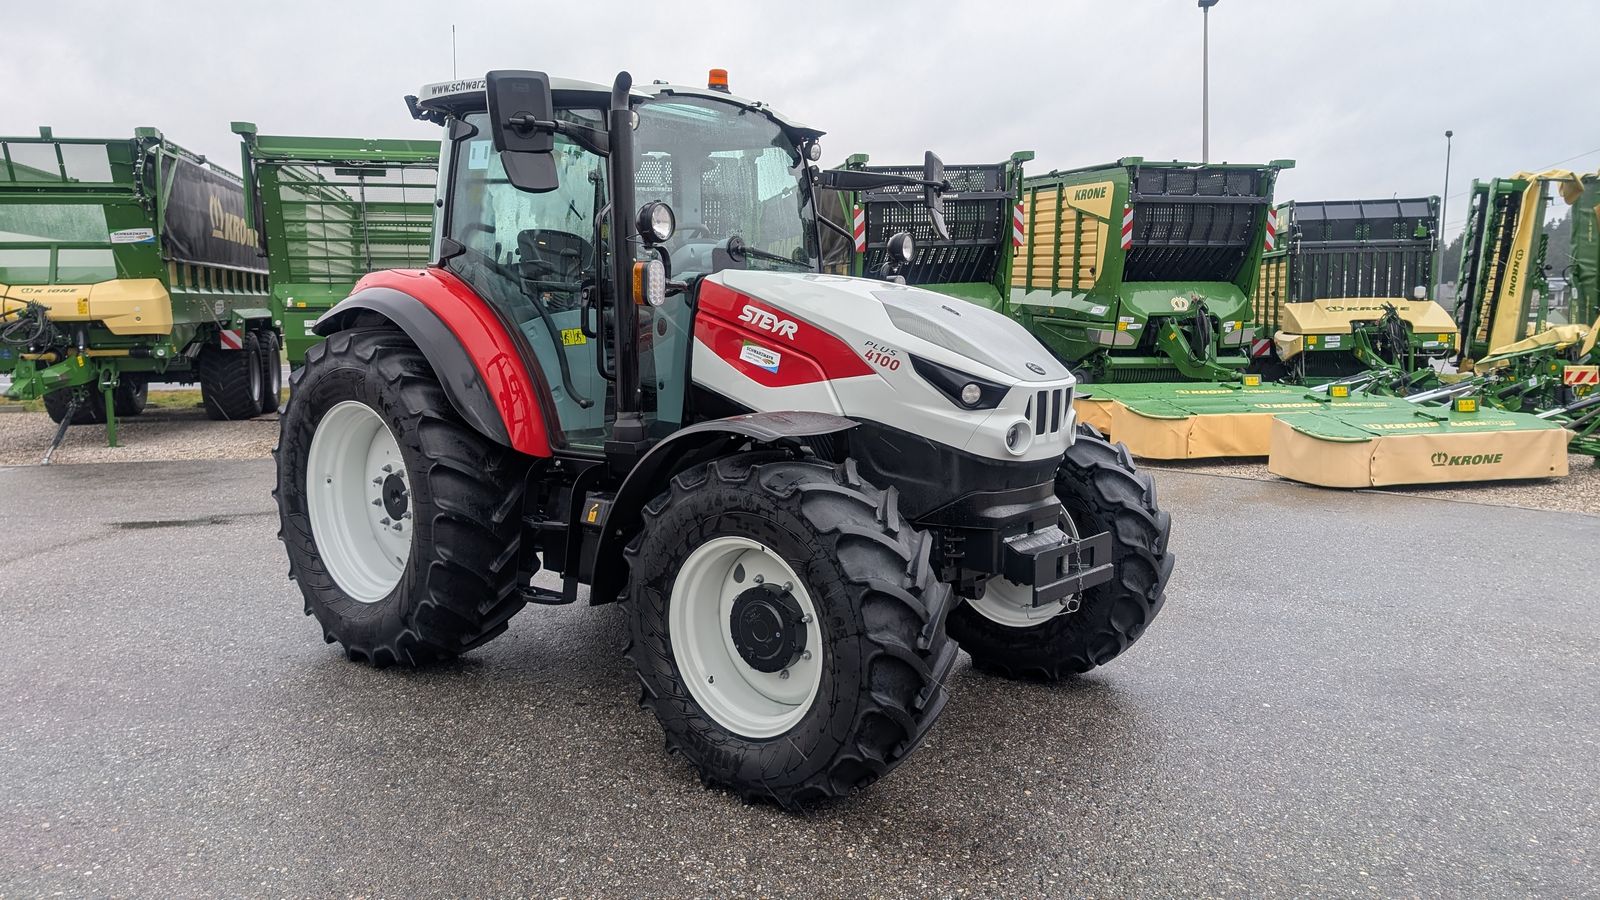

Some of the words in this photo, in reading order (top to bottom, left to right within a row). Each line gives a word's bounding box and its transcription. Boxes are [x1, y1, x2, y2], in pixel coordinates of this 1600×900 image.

[1074, 186, 1107, 201] KRONE
[1508, 260, 1520, 297] KRONE
[737, 304, 798, 341] STEYR
[864, 340, 898, 356] PLUS
[864, 349, 900, 371] 4100
[1382, 421, 1440, 430] KRONE
[1448, 453, 1503, 466] KRONE
